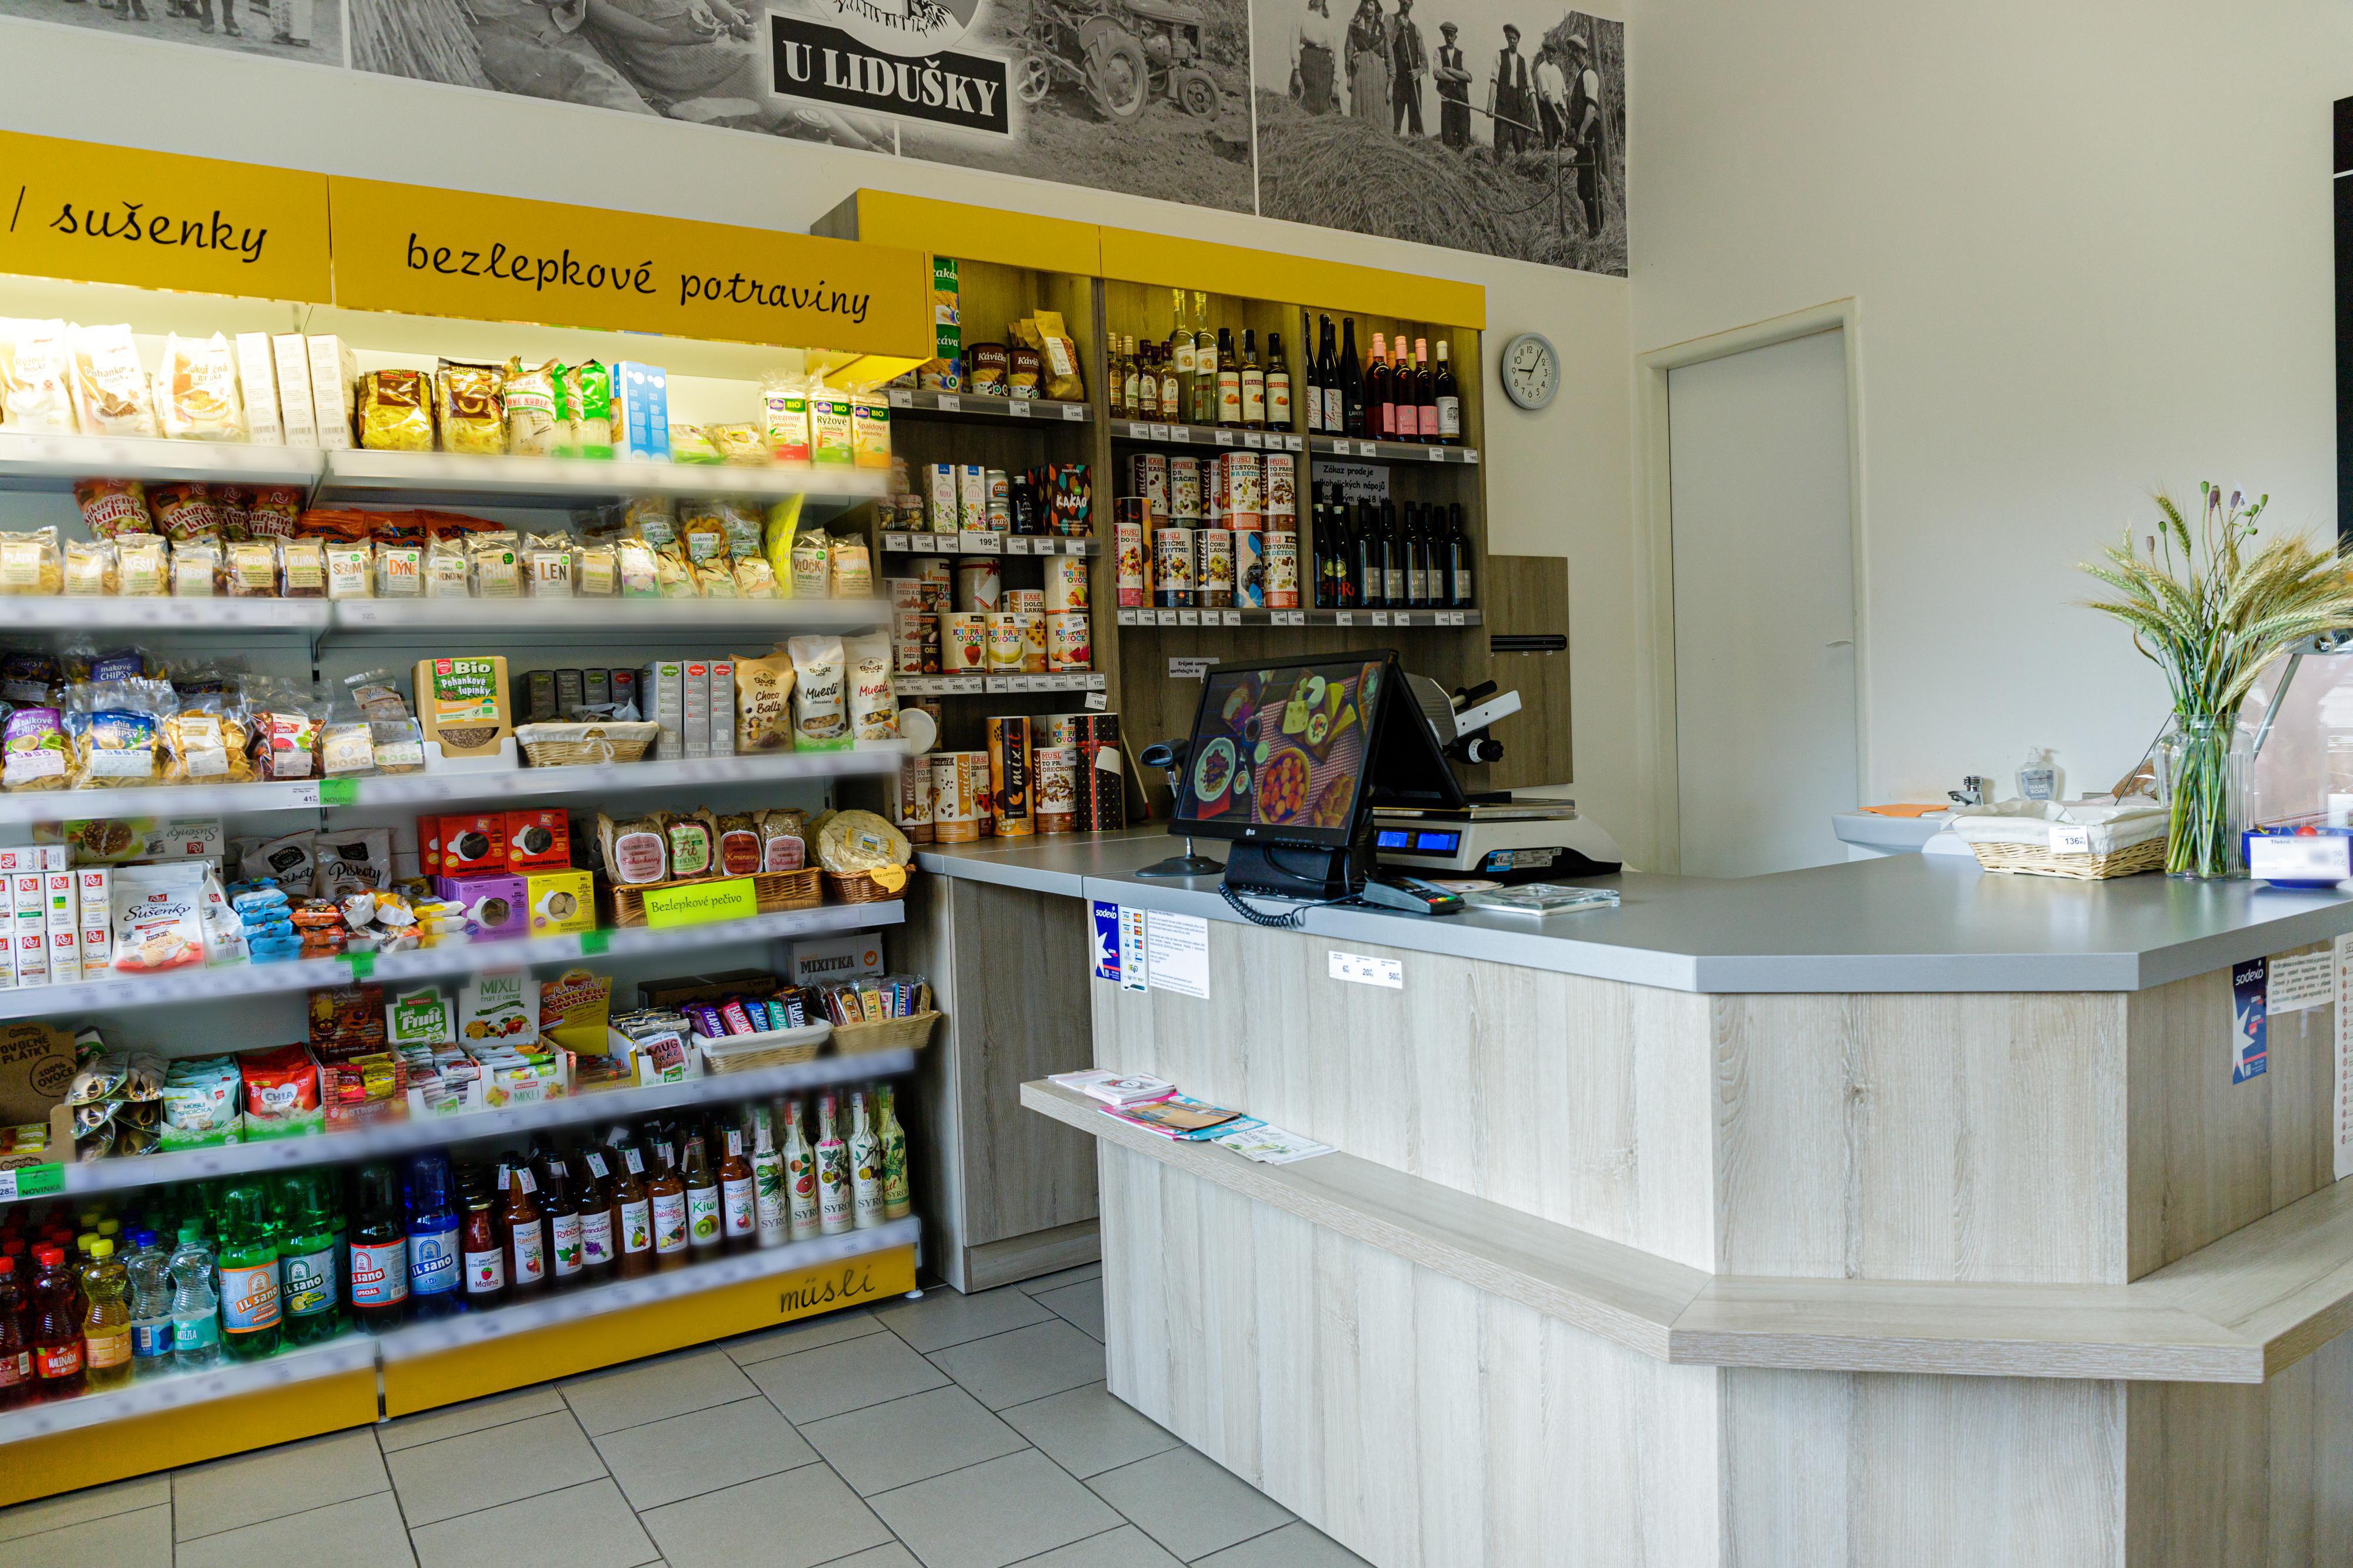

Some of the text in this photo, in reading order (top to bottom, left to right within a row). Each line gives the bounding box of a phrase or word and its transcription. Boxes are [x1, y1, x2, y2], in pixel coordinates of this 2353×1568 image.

[783, 40, 998, 117] U LIDUŠKY
[50, 201, 268, 263] sušenky
[407, 233, 871, 323] bezlepkové potraviny
[817, 416, 847, 426] Rýžové
[857, 421, 886, 431] Špaldové
[1135, 461, 1146, 494] mixit
[1323, 465, 1374, 478] Zákaz prodeje
[1201, 466, 1210, 499] mixit
[1364, 481, 1385, 492] nápojů
[1056, 493, 1087, 508] KAKAO
[691, 535, 716, 543] Lukrena
[124, 555, 156, 573] KEŠU
[238, 553, 271, 566] OŘECHY
[794, 558, 825, 573] VLOČKY
[333, 561, 362, 577] SEZAM
[389, 558, 418, 576] DÝNĚ
[482, 563, 514, 579] CHIA
[540, 561, 568, 581] LEN
[957, 635, 984, 643] OVOCE
[991, 635, 1019, 643] OVOCE
[101, 663, 132, 672] makové
[454, 661, 492, 675] Bio
[859, 664, 884, 673] Bauck
[100, 670, 132, 680] CHIPSY
[441, 676, 486, 689] Pohankové
[458, 684, 491, 697] lupínky
[755, 691, 781, 702] Choco
[805, 683, 838, 699] Muesli
[756, 702, 781, 714] Balls
[11, 716, 53, 728] bazalkové
[112, 719, 131, 729] chia
[16, 724, 48, 736] CHIPSY
[104, 728, 138, 739] CHIPSY
[1006, 731, 1022, 786] mixit
[962, 760, 971, 798] mixit
[1034, 755, 1042, 793] mixit
[676, 840, 698, 858] Fit
[1, 853, 15, 869] Rej
[622, 856, 661, 867] Pohankový
[725, 853, 759, 862] Kmínový
[328, 861, 383, 886] Piškoty
[20, 878, 38, 891] Rej
[51, 877, 69, 890] Rej
[85, 874, 102, 888] Rej
[81, 896, 108, 904] Sušenky
[210, 893, 221, 902] Rej
[651, 893, 742, 913] Bezlepkové pečivo
[123, 903, 191, 922] Sušenky
[1096, 908, 1117, 919] sodexo
[22, 936, 41, 949] Rej
[55, 933, 74, 946] Rej
[86, 930, 105, 943] Rej
[801, 955, 855, 975] MIXITKA
[1389, 972, 1396, 980] 50
[2235, 968, 2264, 987] sodexo
[481, 978, 522, 996] MIXLI
[398, 1007, 415, 1020] just
[402, 1007, 443, 1030] Fruit
[1, 1035, 51, 1055] OVOCNÉ
[647, 1039, 678, 1056] MUG
[2, 1045, 51, 1065] PLÁTKY
[38, 1063, 66, 1077] 100%
[38, 1067, 76, 1088] OVOCE
[265, 1089, 295, 1103] CHIA
[514, 1088, 539, 1103] MIXLI
[178, 1106, 212, 1116] SRDÍČKA
[21, 1183, 62, 1196] NOVINKA
[655, 1207, 681, 1219] Jablíčko
[692, 1199, 717, 1214] Kiwi
[412, 1256, 452, 1277] IL sano
[355, 1269, 384, 1282] sano
[282, 1275, 324, 1296] IL sano
[475, 1277, 498, 1289] Malina
[780, 1265, 876, 1313] müsli
[253, 1286, 278, 1306] sano
[356, 1288, 378, 1296] SPECIÁL
[48, 1353, 78, 1369] MALINÁDA
